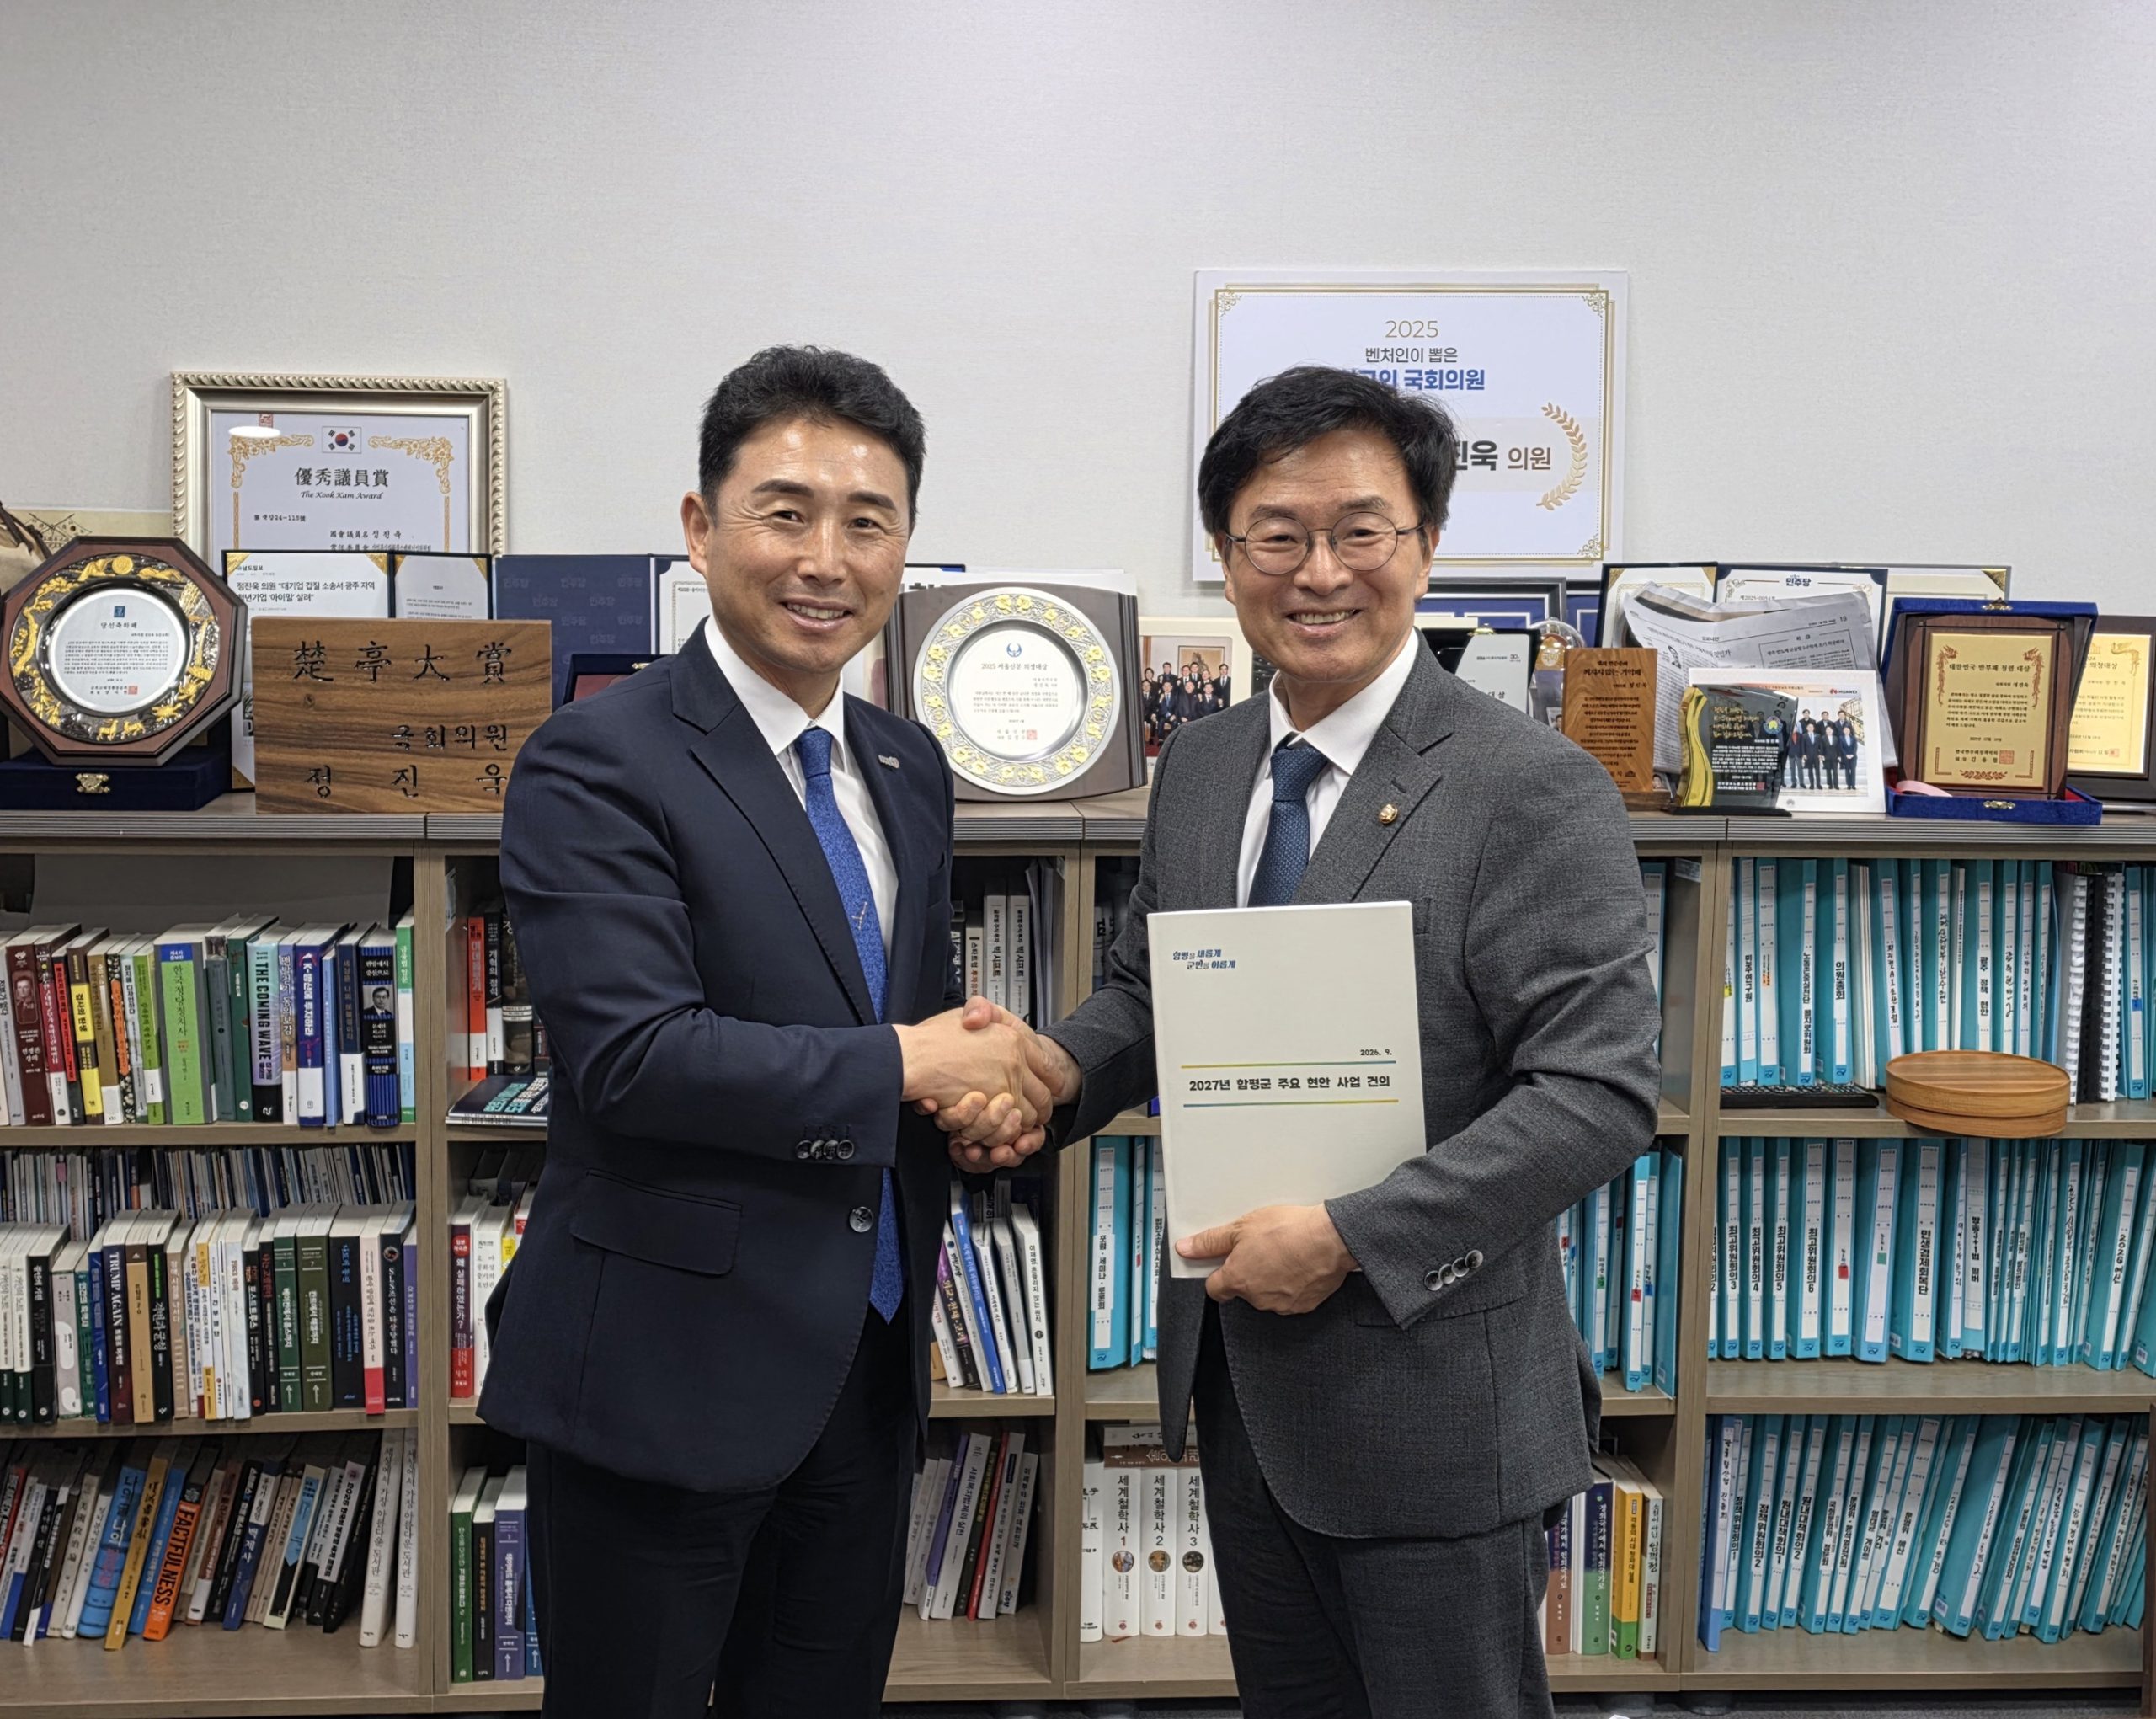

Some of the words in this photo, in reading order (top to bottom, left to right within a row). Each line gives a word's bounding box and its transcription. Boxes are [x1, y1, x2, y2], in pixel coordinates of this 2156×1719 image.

[1385, 320, 1439, 339] 2025
[1365, 348, 1424, 364] 벤처인이
[1428, 347, 1458, 364] 뽑은
[1404, 369, 1485, 391] 국회의원
[1507, 447, 1551, 470] 의원
[295, 467, 389, 488] 優秀議員賞
[315, 491, 334, 499] Kook
[237, 582, 259, 590] 정진욱
[261, 582, 276, 590] 의원
[306, 582, 320, 590] 갑질
[322, 582, 344, 590] 소송서
[345, 582, 360, 590] 광주
[361, 581, 376, 590] 지역
[1785, 577, 1812, 587] 민주당
[292, 640, 513, 686] 楚亭大賞
[1949, 663, 1976, 671] 대한민국
[390, 724, 508, 751] 국회의원
[970, 942, 979, 968] 스타트업
[1172, 951, 1195, 961] 함평을
[1197, 949, 1222, 958] 새롭게
[1211, 959, 1236, 969] 이롭게
[256, 961, 270, 983] THE
[280, 955, 292, 994] 맨발걷기
[1835, 961, 1845, 1000] 의원총회
[173, 964, 188, 1037] 한국정당정치사
[256, 985, 270, 1027] COMING
[282, 996, 293, 1035] 동의보감
[304, 1002, 314, 1036] 투자하라
[258, 1028, 272, 1060] WAVE
[1188, 1080, 1230, 1091] 2027년
[1236, 1078, 1272, 1090] 함평군
[1278, 1078, 1301, 1090] 주요
[1307, 1076, 1331, 1089] 현안
[1337, 1076, 1361, 1089] 사업
[1367, 1076, 1390, 1087] 건의
[109, 1252, 121, 1295] TRUMP
[1728, 1225, 1738, 1289] 최고위원회의3
[1751, 1226, 1761, 1292] 최고위원회의4
[1774, 1225, 1786, 1291] 최고위원회의5
[1807, 1228, 1818, 1293] 최고위원회의6
[1918, 1229, 1932, 1295] 민생경제회복단
[112, 1296, 123, 1331] AGAIN
[343, 1482, 354, 1507] 2025
[1118, 1475, 1129, 1534] 세계철학사
[1154, 1475, 1165, 1534] 세계철학사
[1187, 1476, 1200, 1535] 세계철학사
[1120, 1535, 1127, 1546] 1
[1155, 1535, 1164, 1546] 2
[1190, 1536, 1198, 1547] 3
[1775, 1500, 1791, 1565] 원내대책회의1
[1794, 1496, 1812, 1560] 원내대책회의2
[154, 1508, 195, 1606] FACTFULNESS
